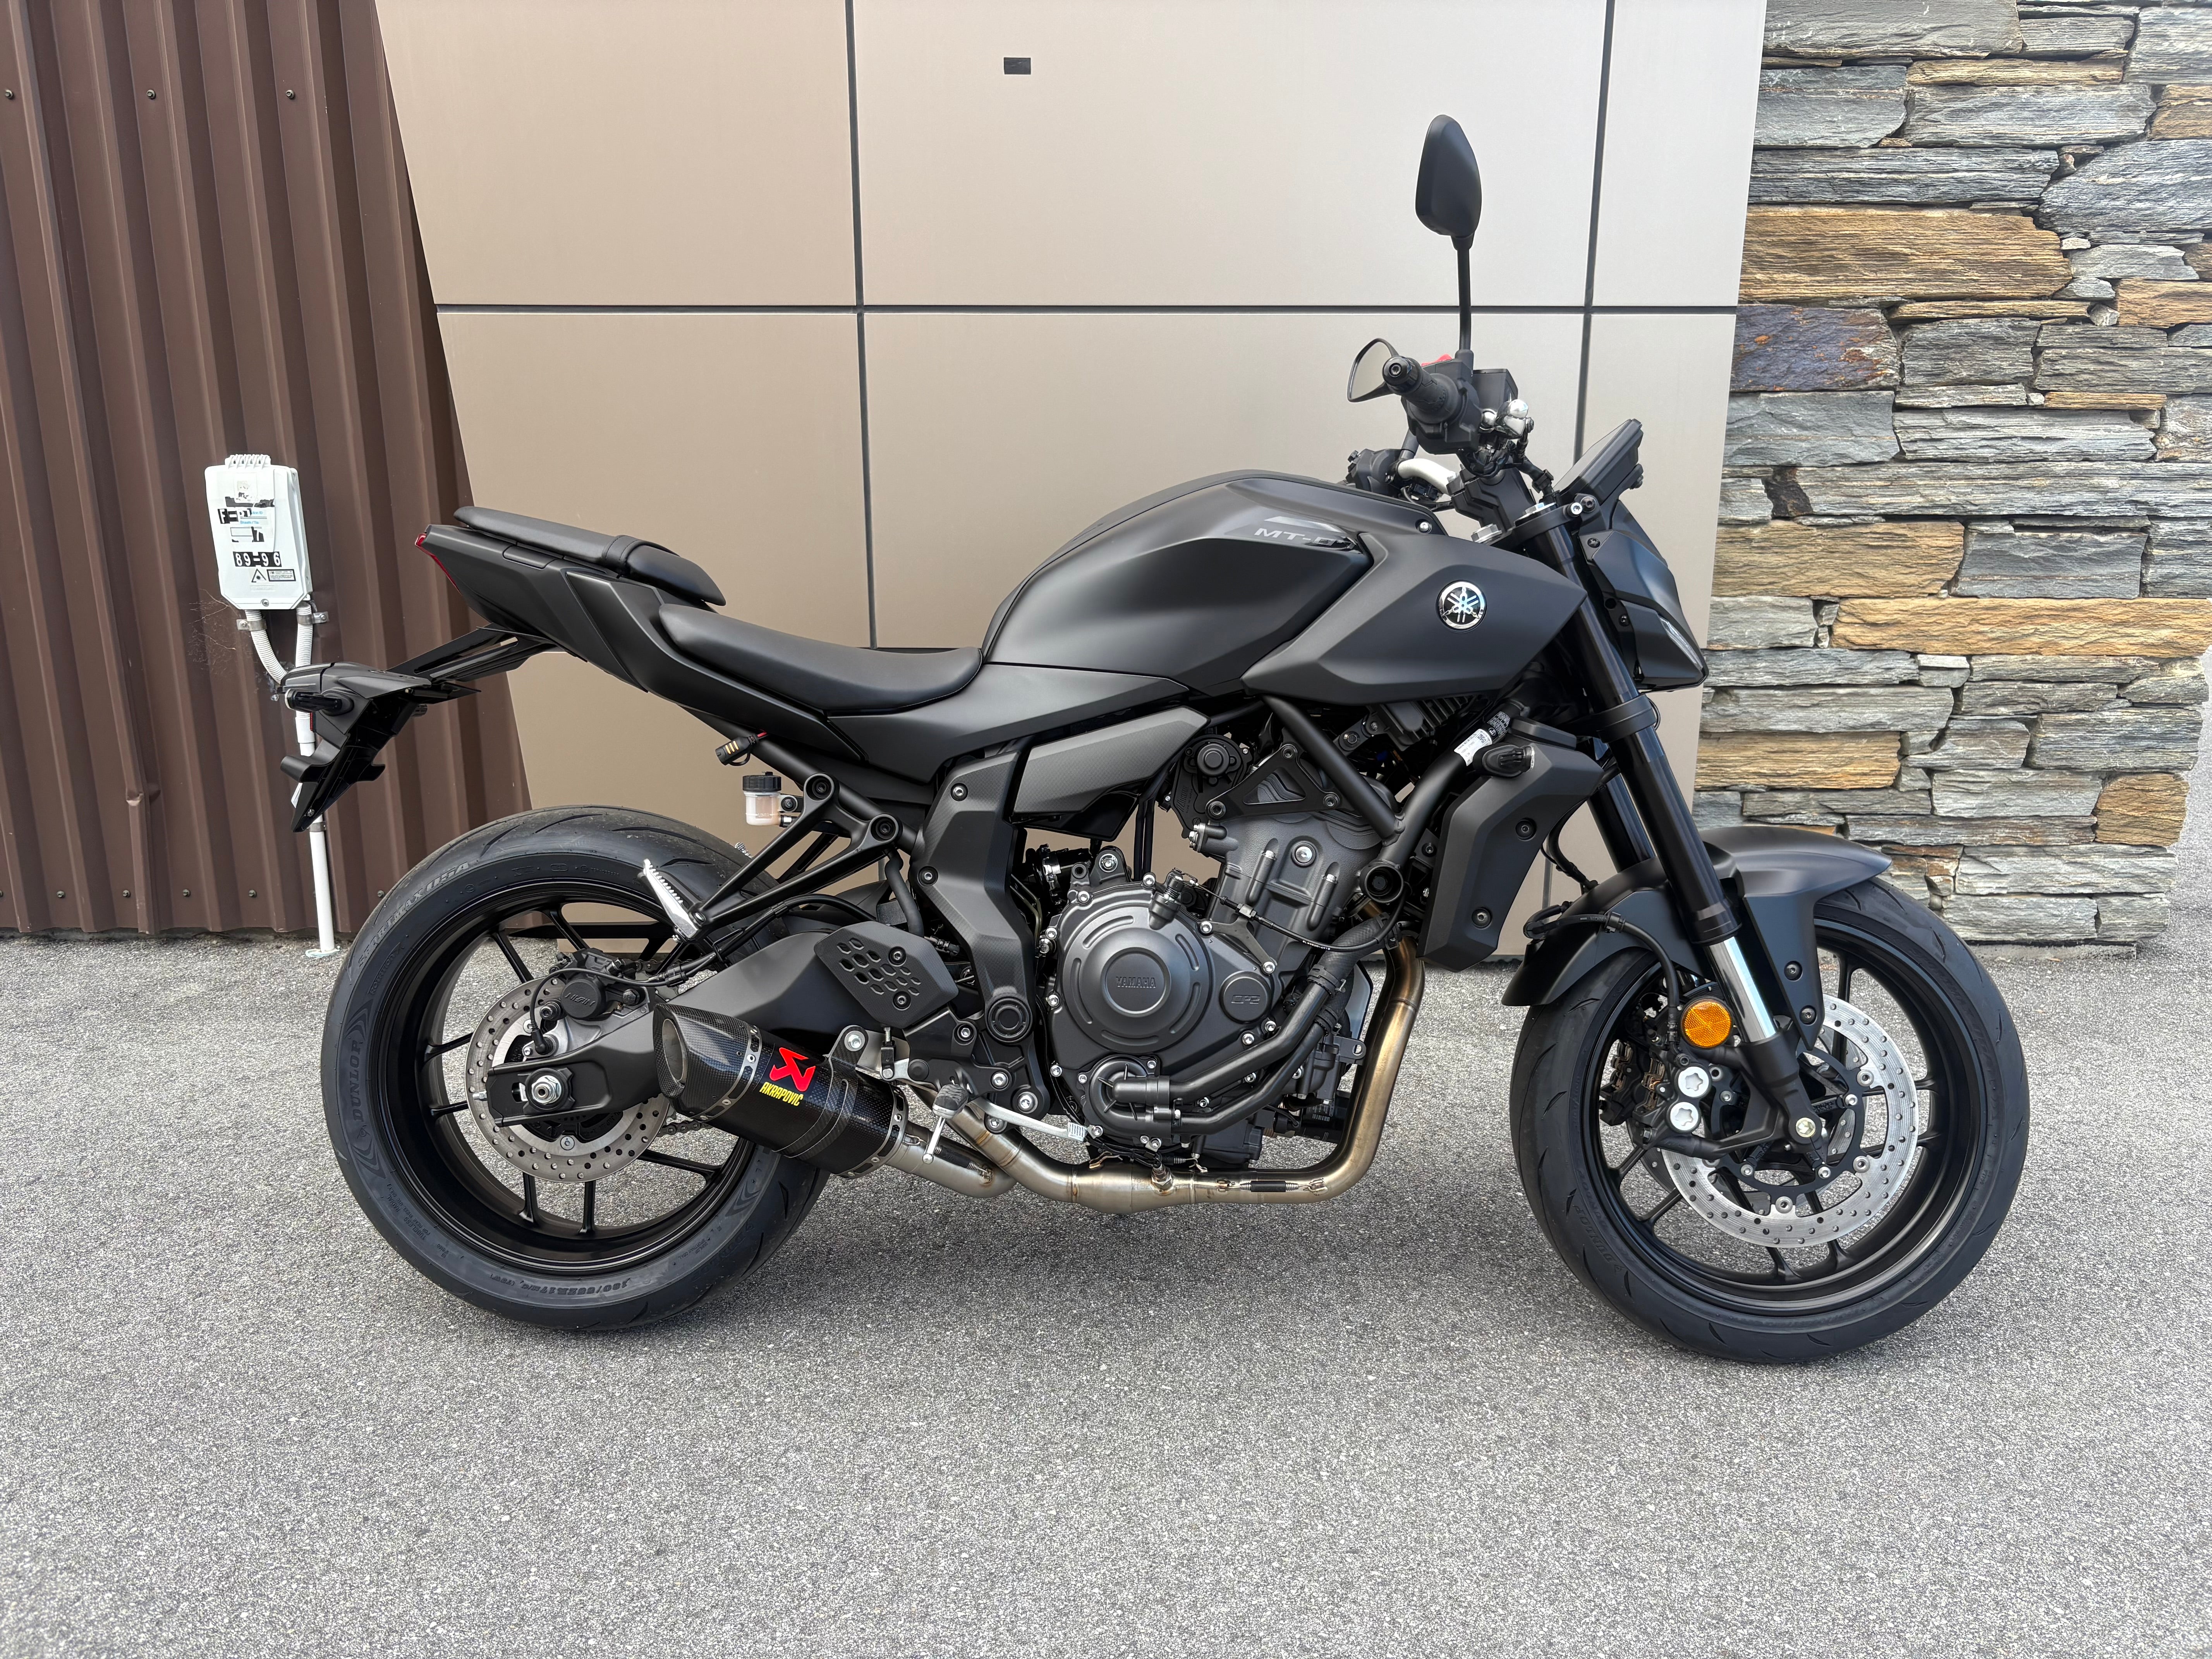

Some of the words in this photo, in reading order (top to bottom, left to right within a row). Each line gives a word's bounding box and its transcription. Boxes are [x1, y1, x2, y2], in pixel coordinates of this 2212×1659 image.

[1116, 977, 1156, 988] YAMAHA
[349, 1041, 364, 1122] DUNLOP
[759, 1082, 804, 1106] AKRAPOVIČ
[403, 1216, 426, 1240] TUBELESS
[1572, 1205, 1616, 1264] DUNLOP
